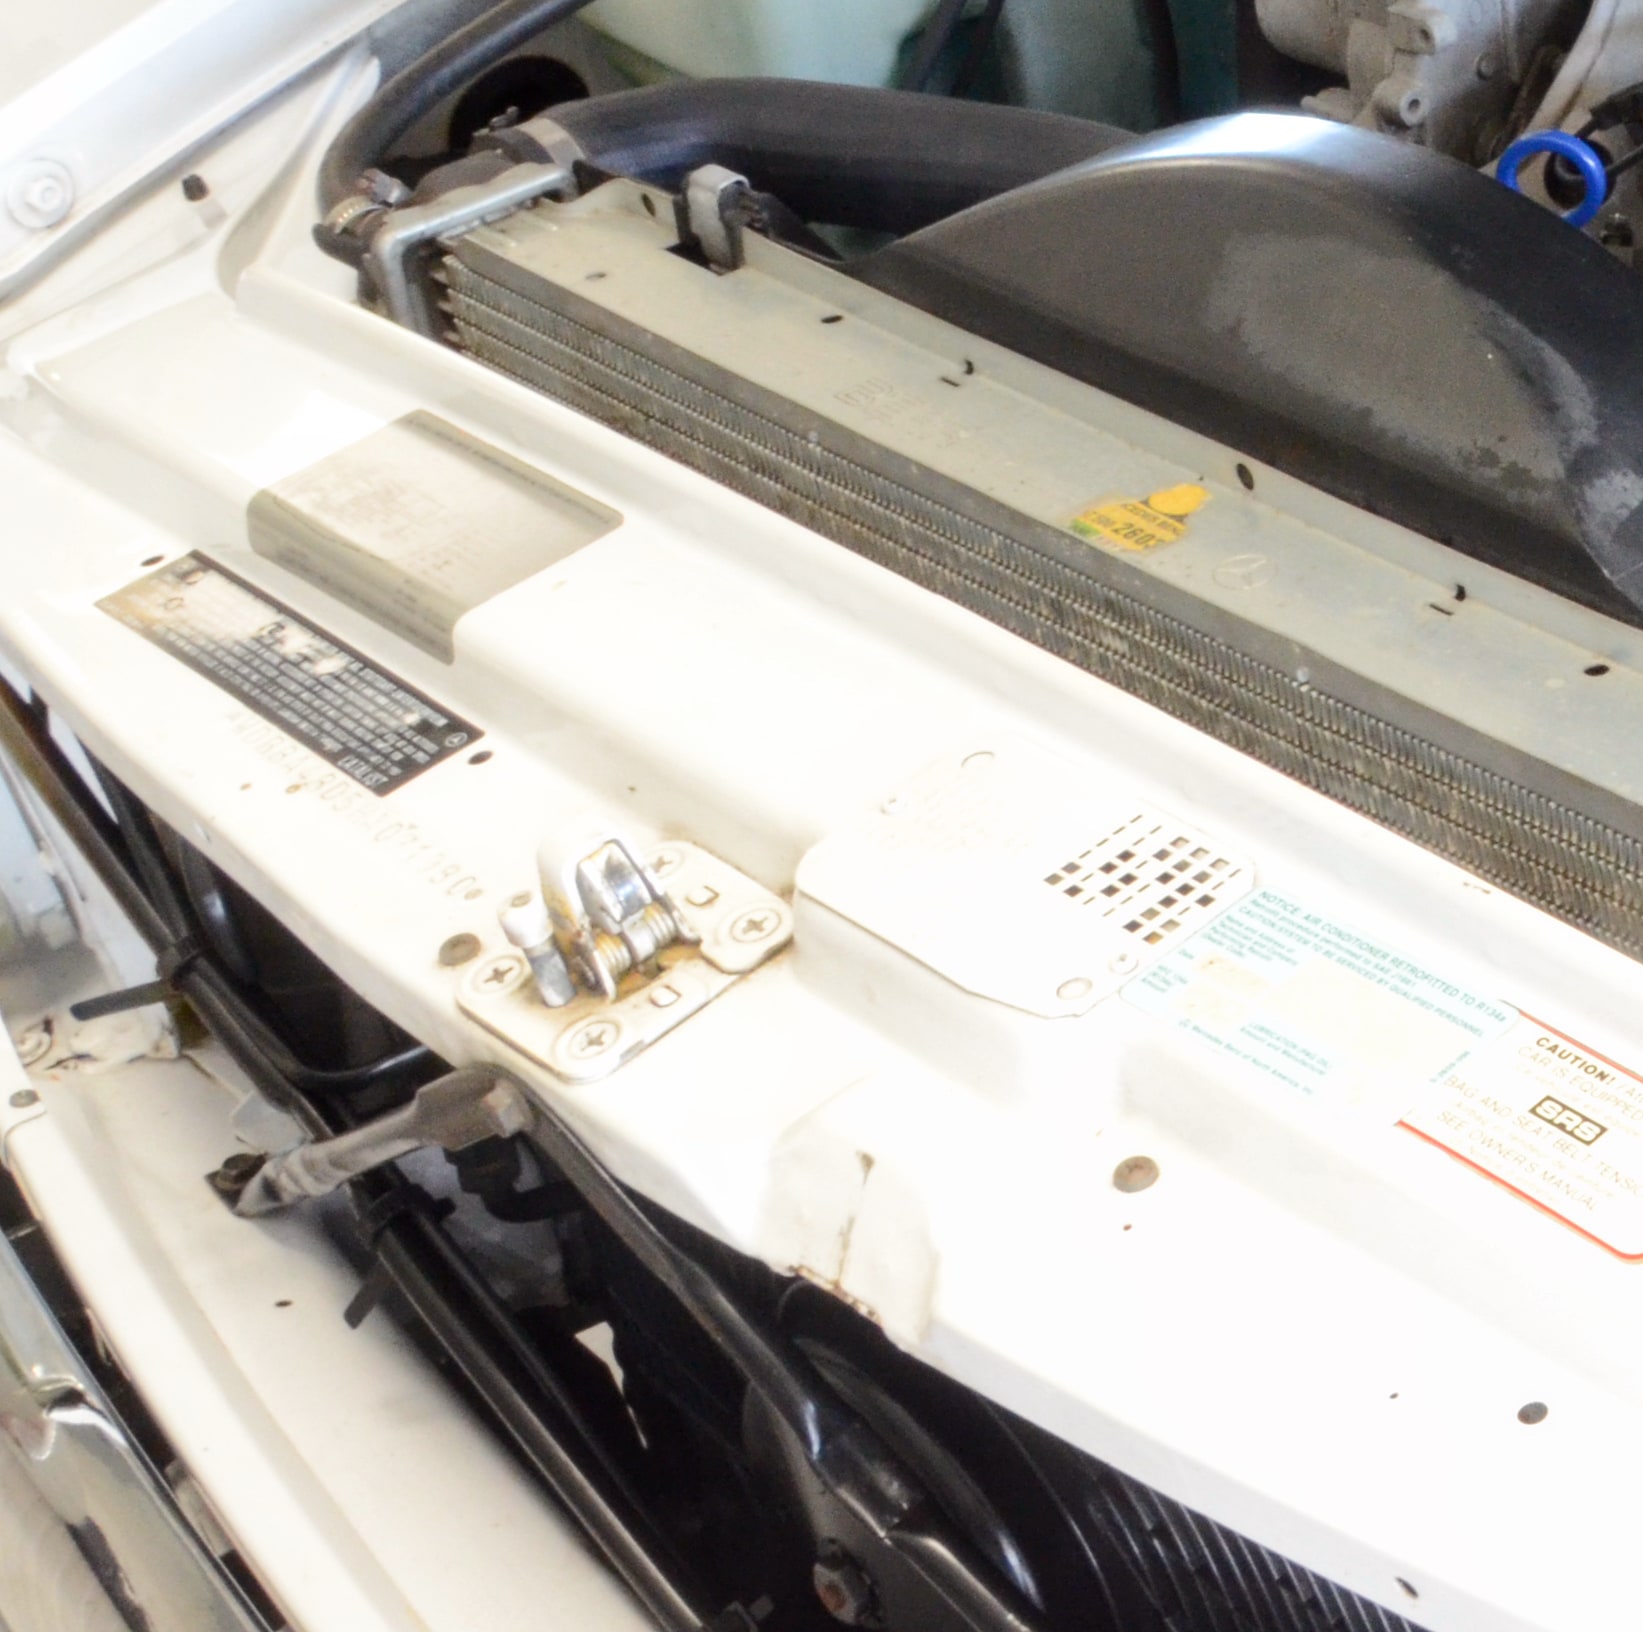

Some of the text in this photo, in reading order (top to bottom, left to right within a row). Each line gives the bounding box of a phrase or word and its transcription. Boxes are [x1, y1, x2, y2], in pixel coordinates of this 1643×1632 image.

[1301, 914, 1322, 926] AIR
[1320, 923, 1390, 960] CONDITIONER
[1458, 994, 1477, 1005] TO
[1516, 1045, 1552, 1069] CAR
[1549, 1063, 1570, 1079] IS
[1534, 1036, 1616, 1085] CAUTION!
[1437, 1110, 1467, 1132] SEE
[1443, 1075, 1479, 1099] BAG
[1478, 1095, 1513, 1119] AND
[1512, 1115, 1552, 1143] SEAT
[1551, 1138, 1590, 1165] BELT
[1535, 1099, 1601, 1142] SRS
